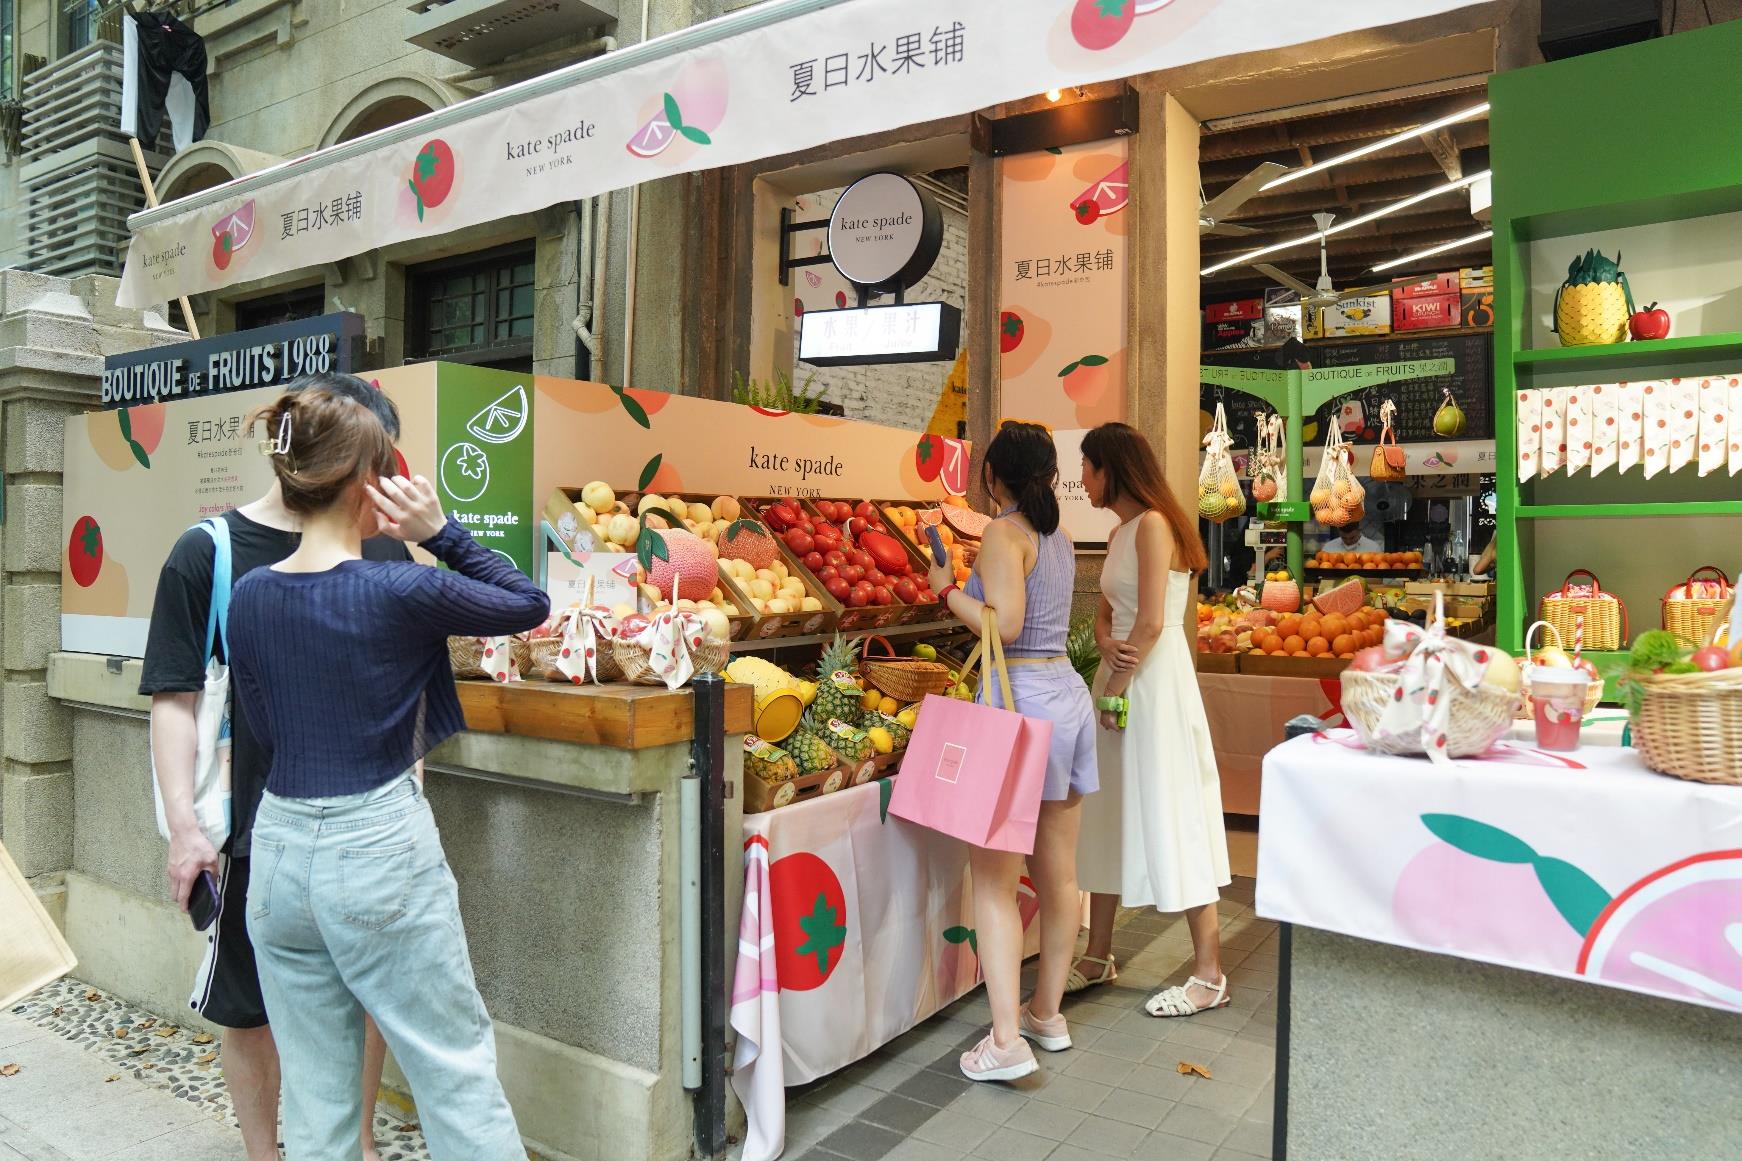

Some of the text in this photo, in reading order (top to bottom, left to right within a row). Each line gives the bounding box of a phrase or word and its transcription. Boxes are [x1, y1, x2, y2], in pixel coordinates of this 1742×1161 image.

[788, 20, 966, 103] 夏日水果铺
[506, 119, 596, 161] kate spade
[525, 154, 573, 177] NEW YORK
[280, 189, 364, 241] 夏日水果铺
[840, 211, 913, 231] kate spade
[855, 233, 895, 243] NEW YORK
[142, 241, 187, 269] kate spade
[1014, 248, 1114, 282] 夏日水果铺
[1335, 297, 1377, 311] Sunkist
[1412, 302, 1440, 313] KIWI
[101, 333, 332, 404] BOUTIQUE DE FRUITS 1988
[1308, 368, 1363, 382] BOUTIQUE
[1376, 364, 1416, 377] FRUITS
[748, 445, 843, 481] kate spade
[769, 484, 822, 498] NEW YORK
[1062, 480, 1084, 493] spa
[453, 509, 519, 528] kate spade
[567, 578, 616, 590] 夏日果铺
